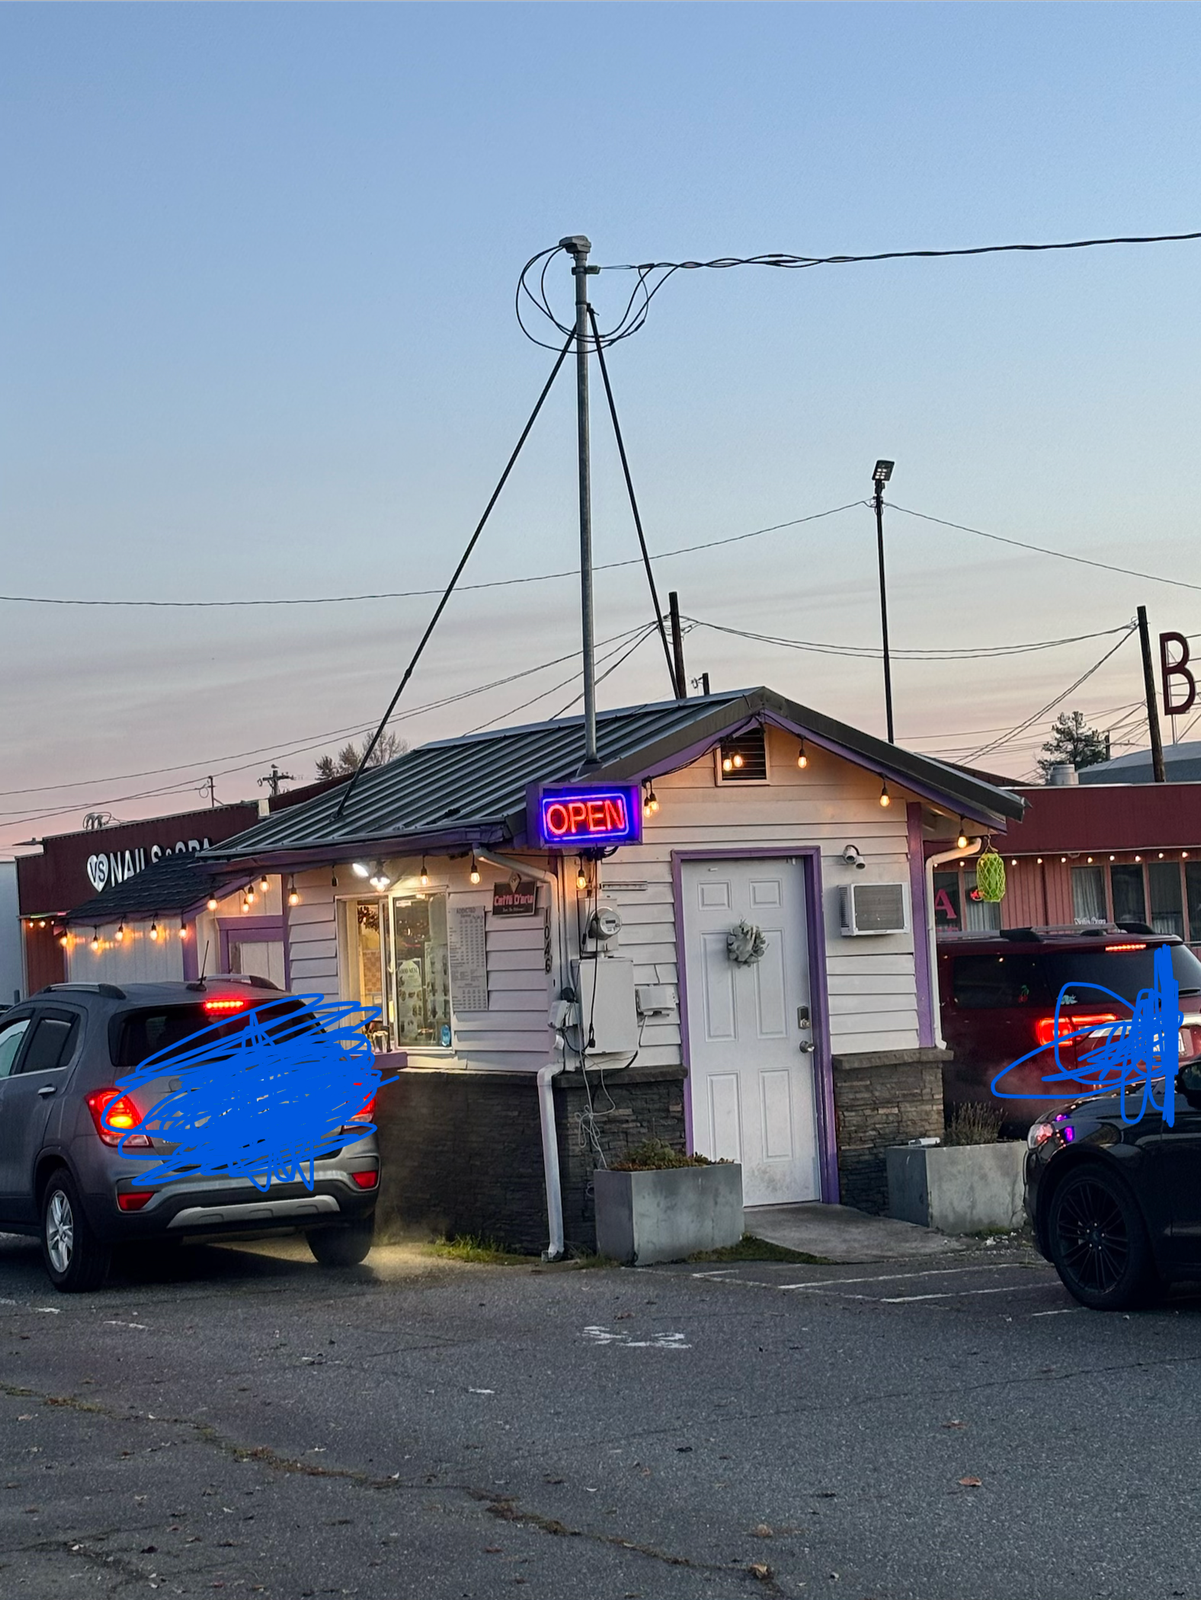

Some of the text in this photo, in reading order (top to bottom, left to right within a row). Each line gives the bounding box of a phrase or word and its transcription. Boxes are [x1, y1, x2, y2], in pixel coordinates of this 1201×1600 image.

[1159, 632, 1196, 715] B
[546, 799, 625, 835] OPEN
[89, 860, 106, 882] VS
